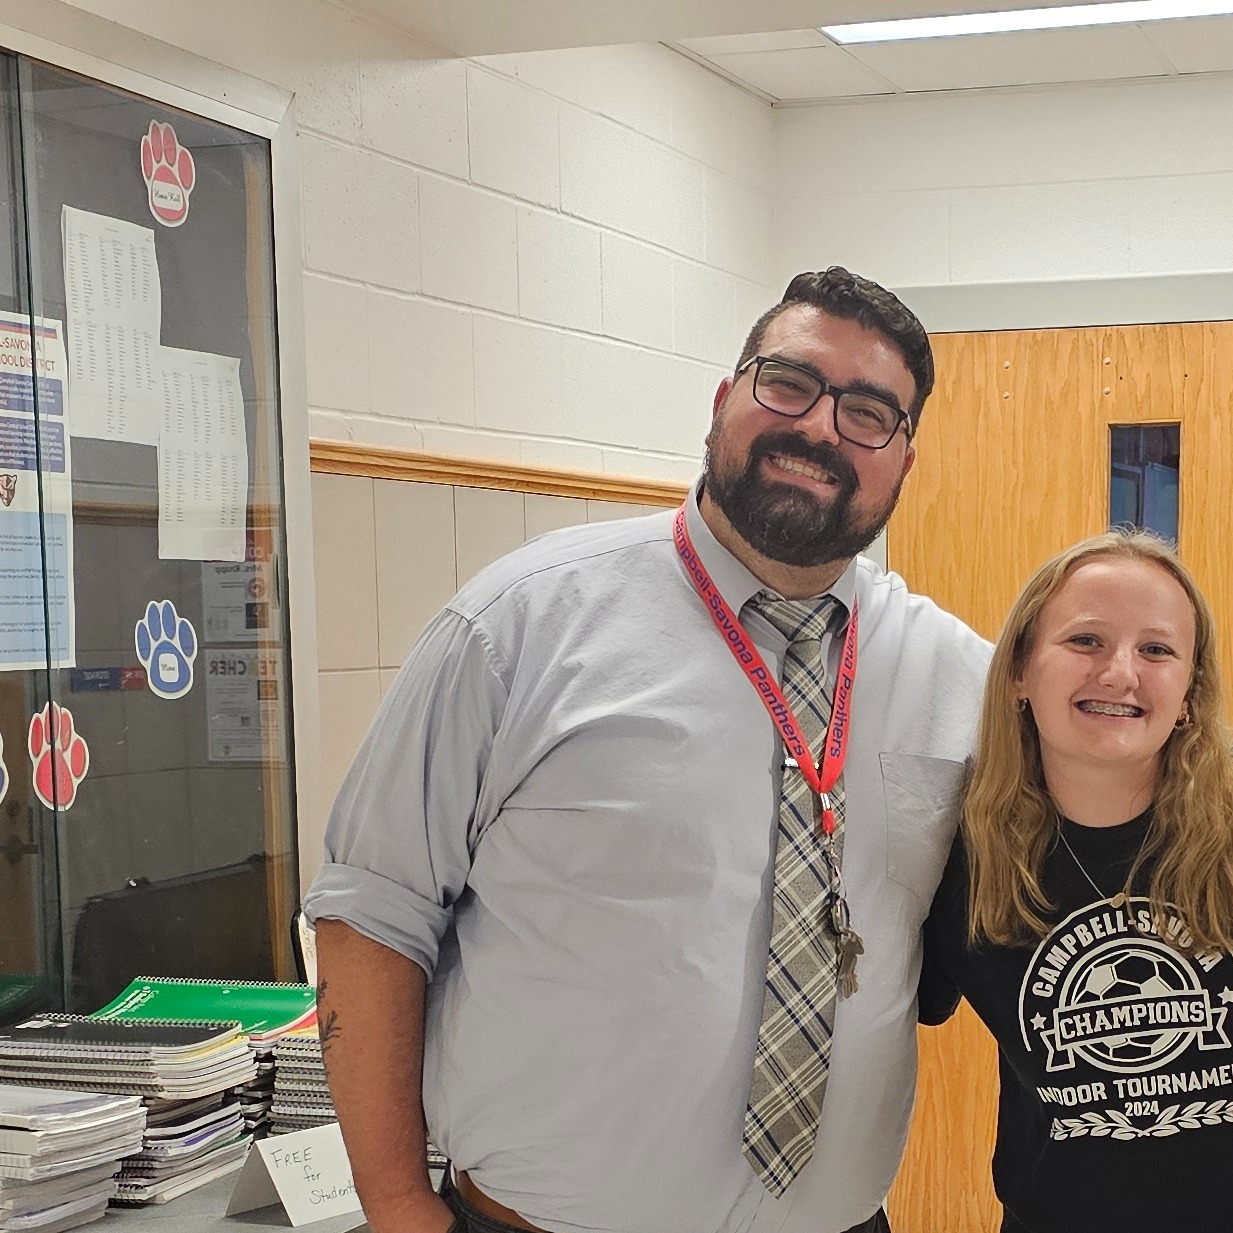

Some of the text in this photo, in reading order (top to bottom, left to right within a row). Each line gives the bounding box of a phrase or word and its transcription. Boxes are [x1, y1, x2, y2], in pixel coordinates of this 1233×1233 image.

[750, 666, 805, 756] Panthers
[830, 672, 851, 758] Panthers
[1059, 1001, 1206, 1040] CHAMPIONS
[1124, 1101, 1160, 1117] 2024
[270, 1146, 312, 1168] FREE
[302, 1164, 321, 1182] for
